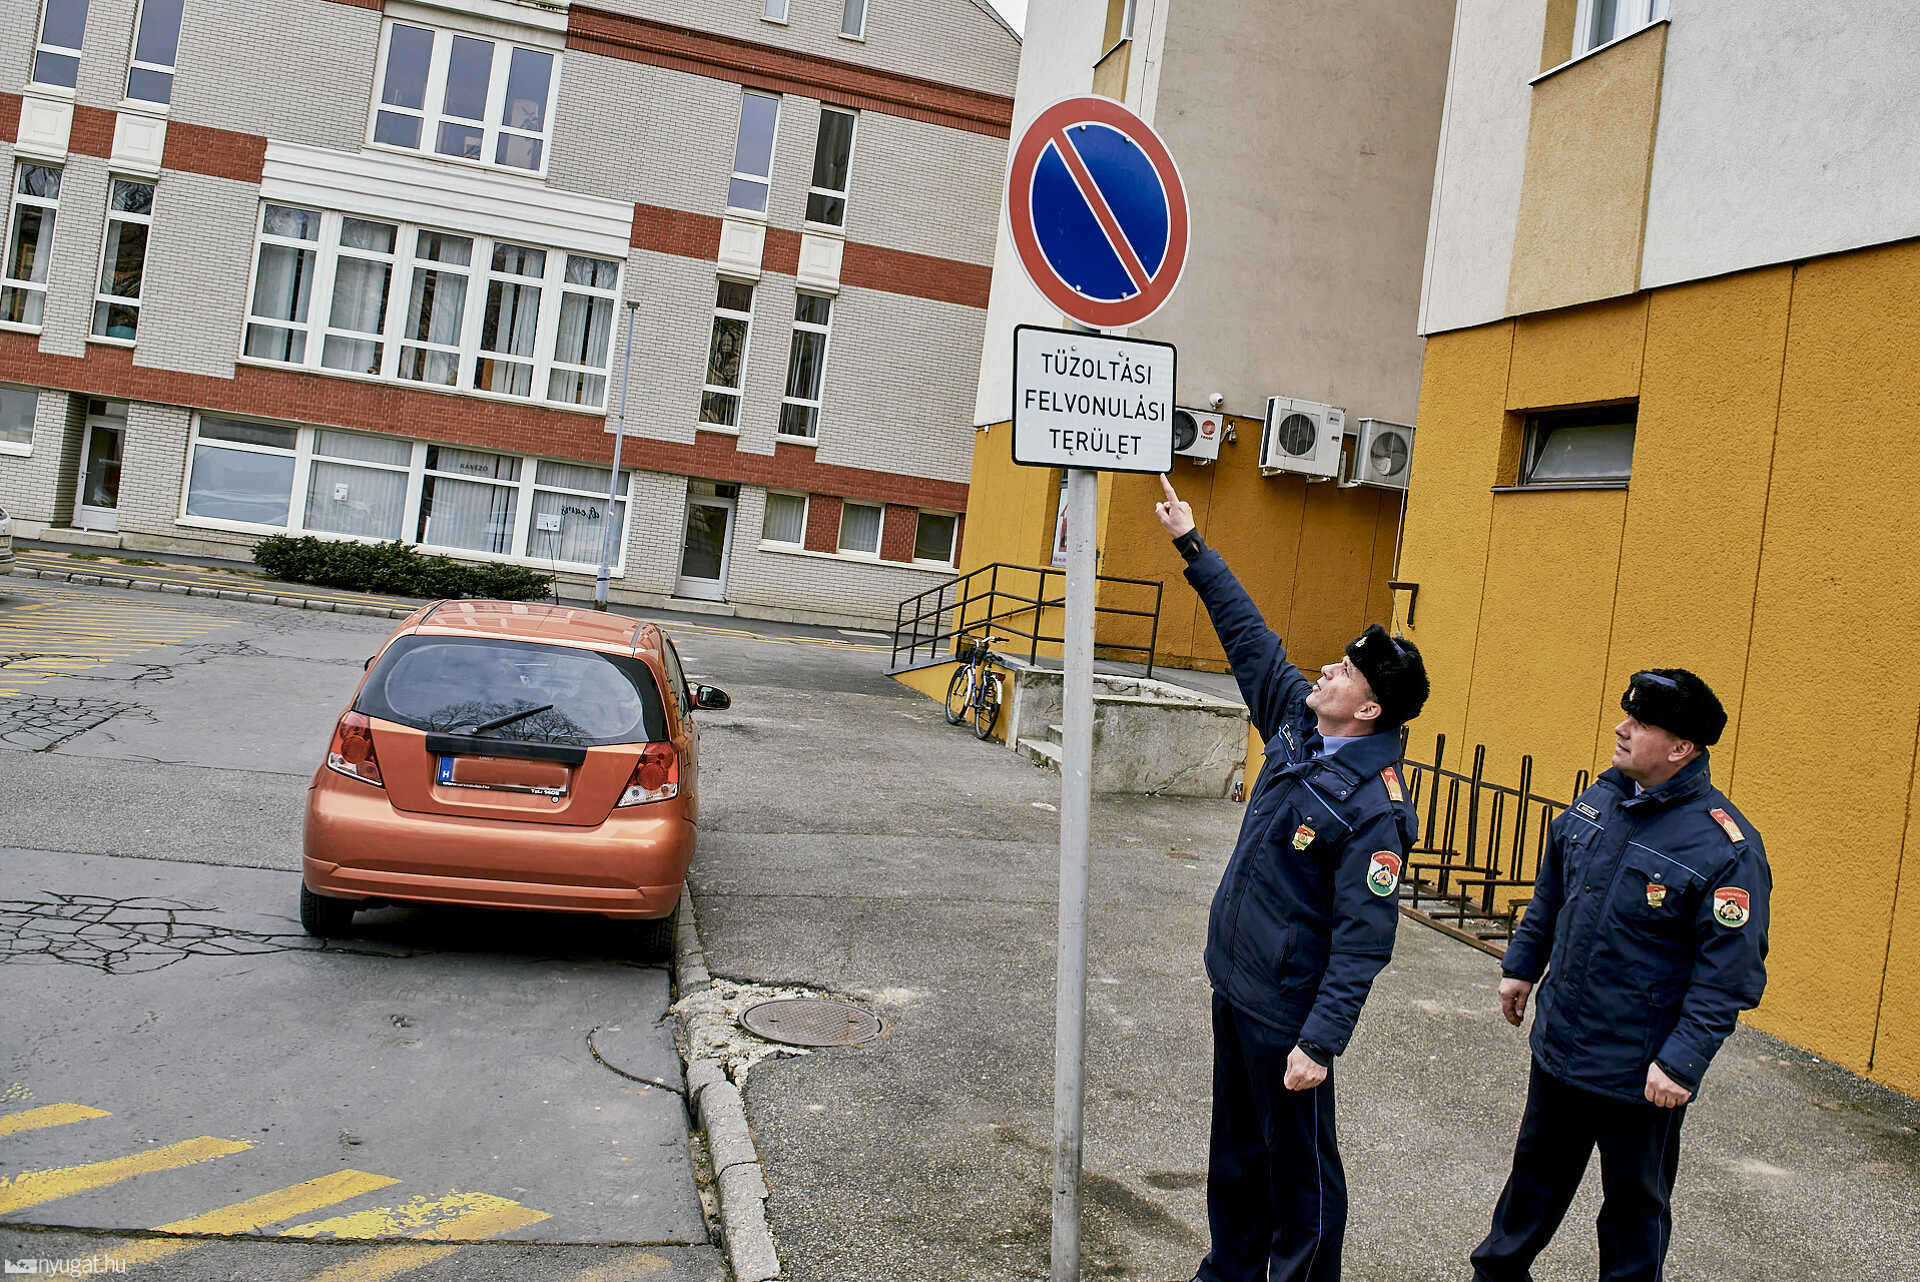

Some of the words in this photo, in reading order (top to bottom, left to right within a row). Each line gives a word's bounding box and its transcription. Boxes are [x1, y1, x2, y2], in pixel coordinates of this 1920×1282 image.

[1025, 389, 1165, 422] FELVONULÁSI
[1049, 427, 1142, 455] TERÜLET
[442, 770, 450, 778] H
